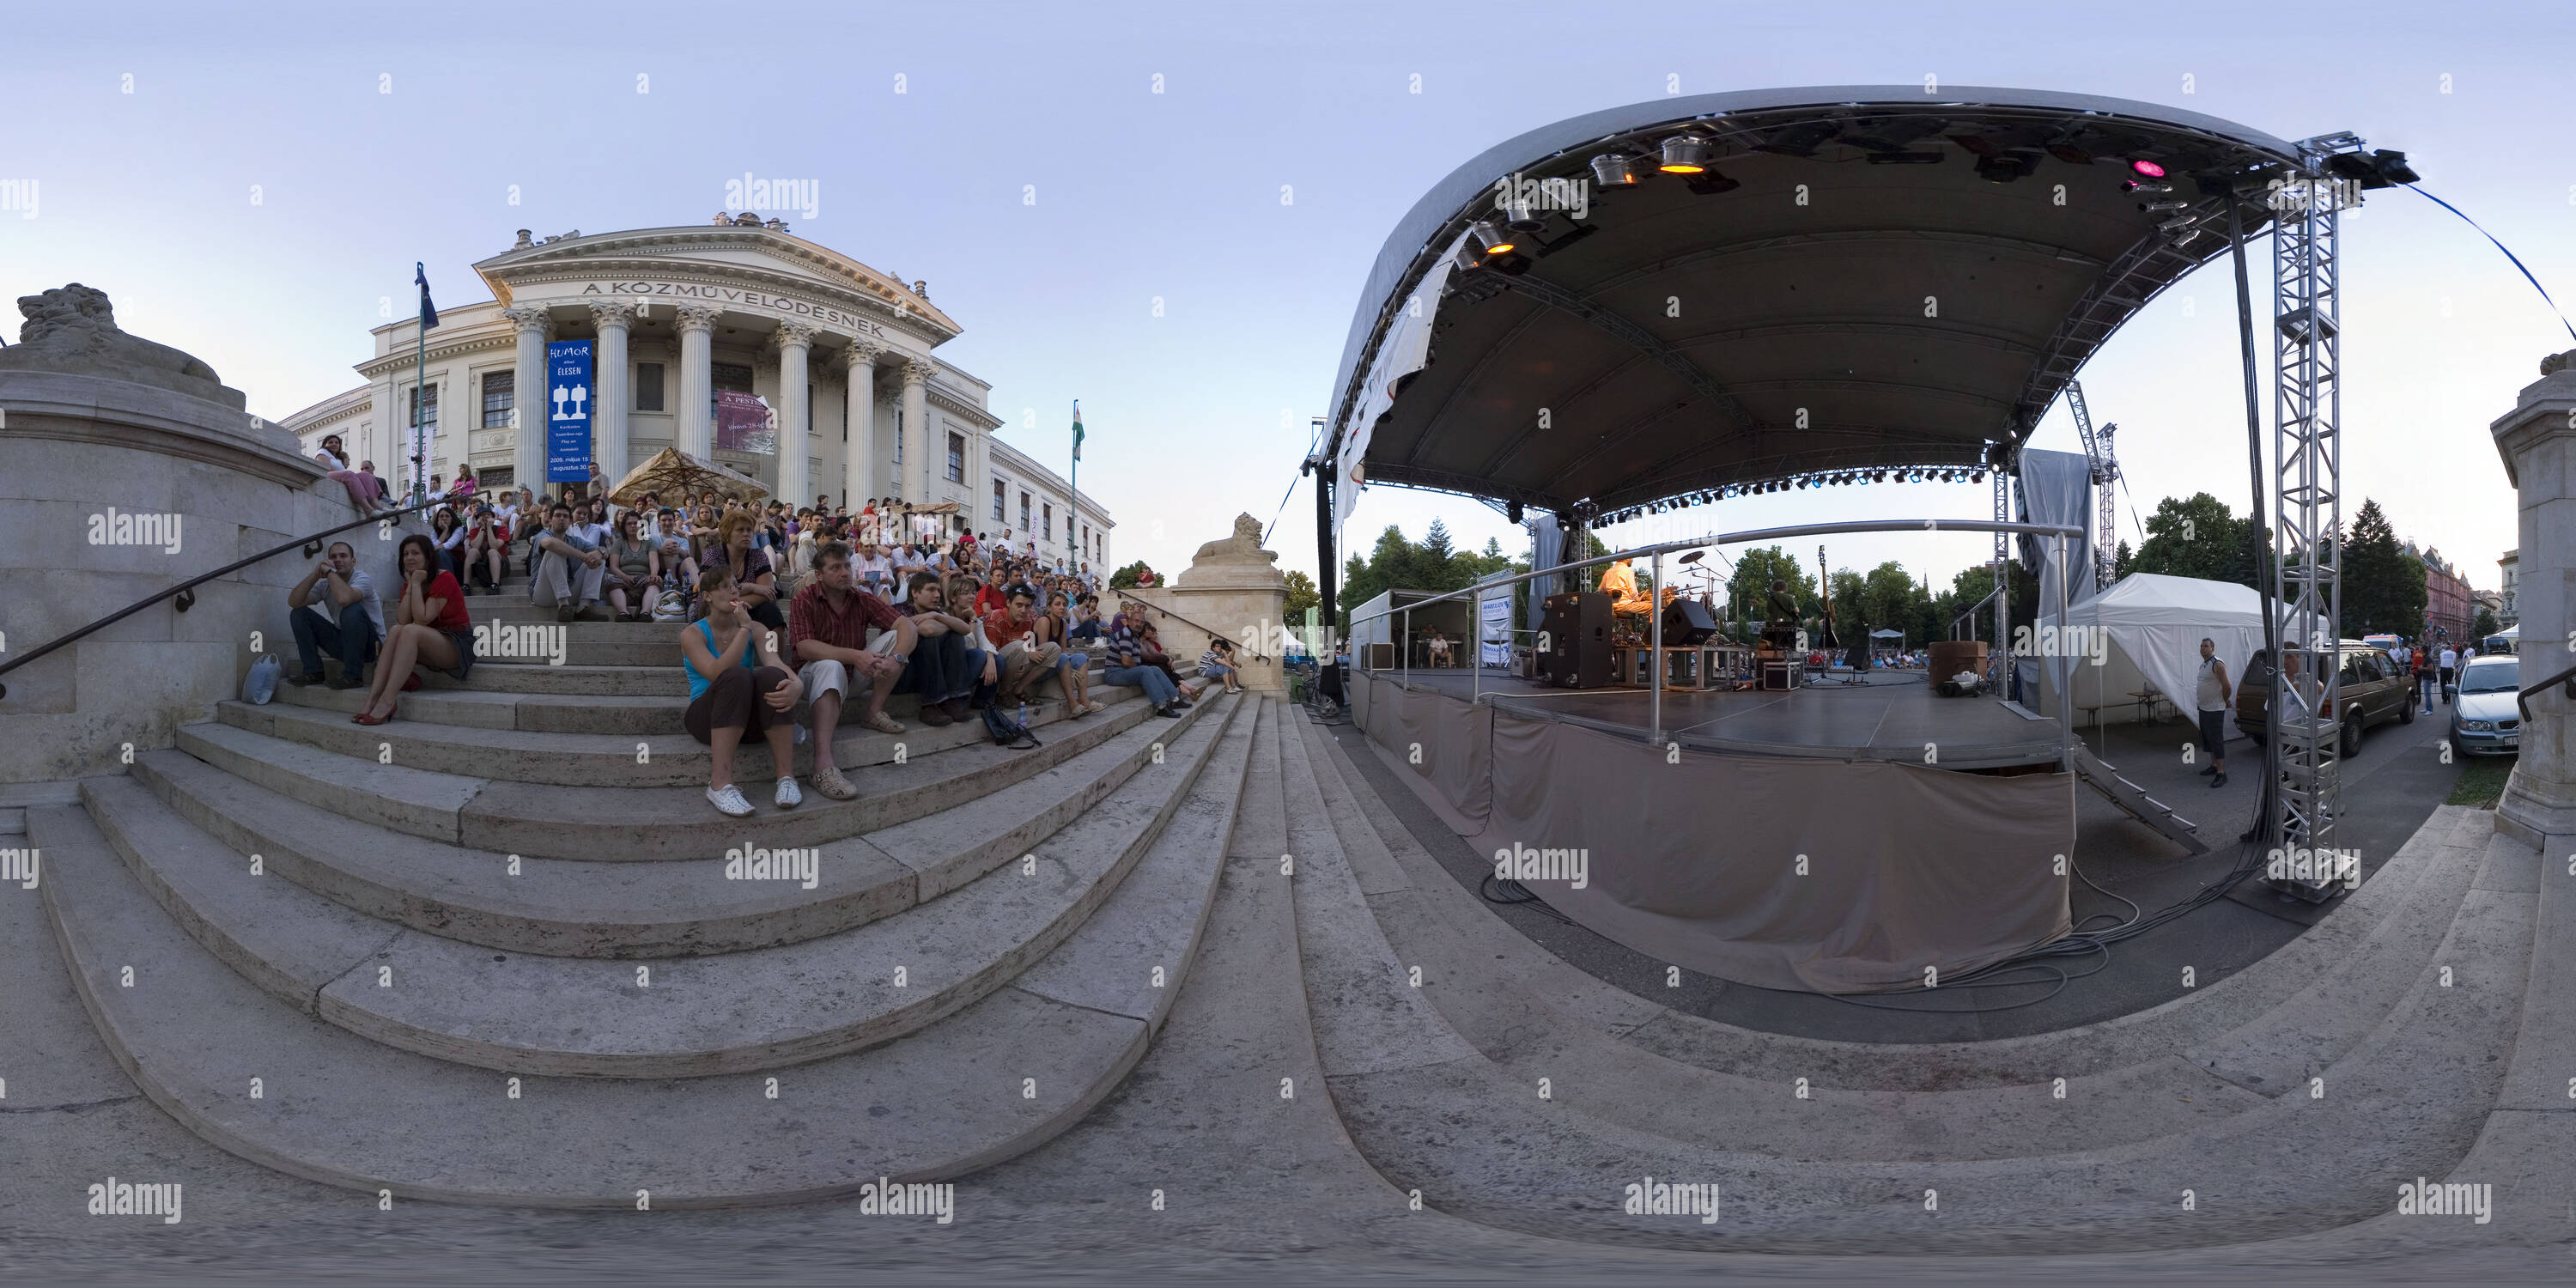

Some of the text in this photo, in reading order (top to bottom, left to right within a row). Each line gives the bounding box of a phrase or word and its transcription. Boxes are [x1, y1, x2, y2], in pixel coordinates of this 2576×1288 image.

[583, 283, 603, 295] A
[550, 346, 590, 358] HUMOR
[557, 367, 581, 376] ÉLESEN
